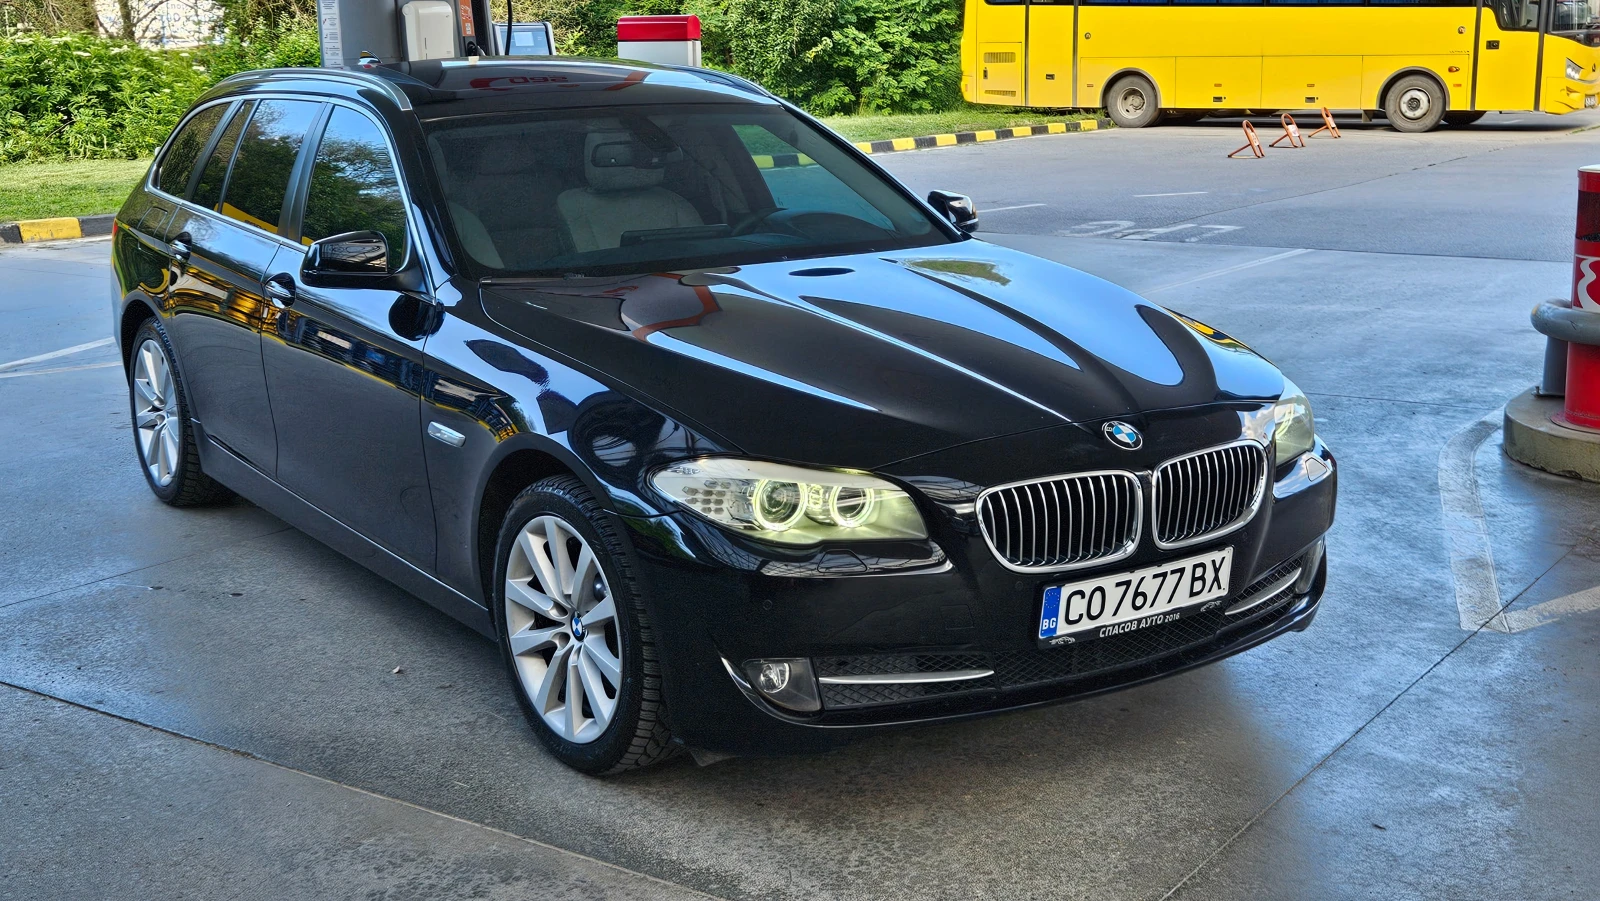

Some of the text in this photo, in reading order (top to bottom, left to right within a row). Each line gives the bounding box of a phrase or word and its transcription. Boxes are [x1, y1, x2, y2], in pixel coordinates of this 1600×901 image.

[1065, 556, 1225, 625] CO 7677 BX
[1043, 618, 1056, 629] BG
[1100, 613, 1179, 637] СПАСОВ АУТО 2016
